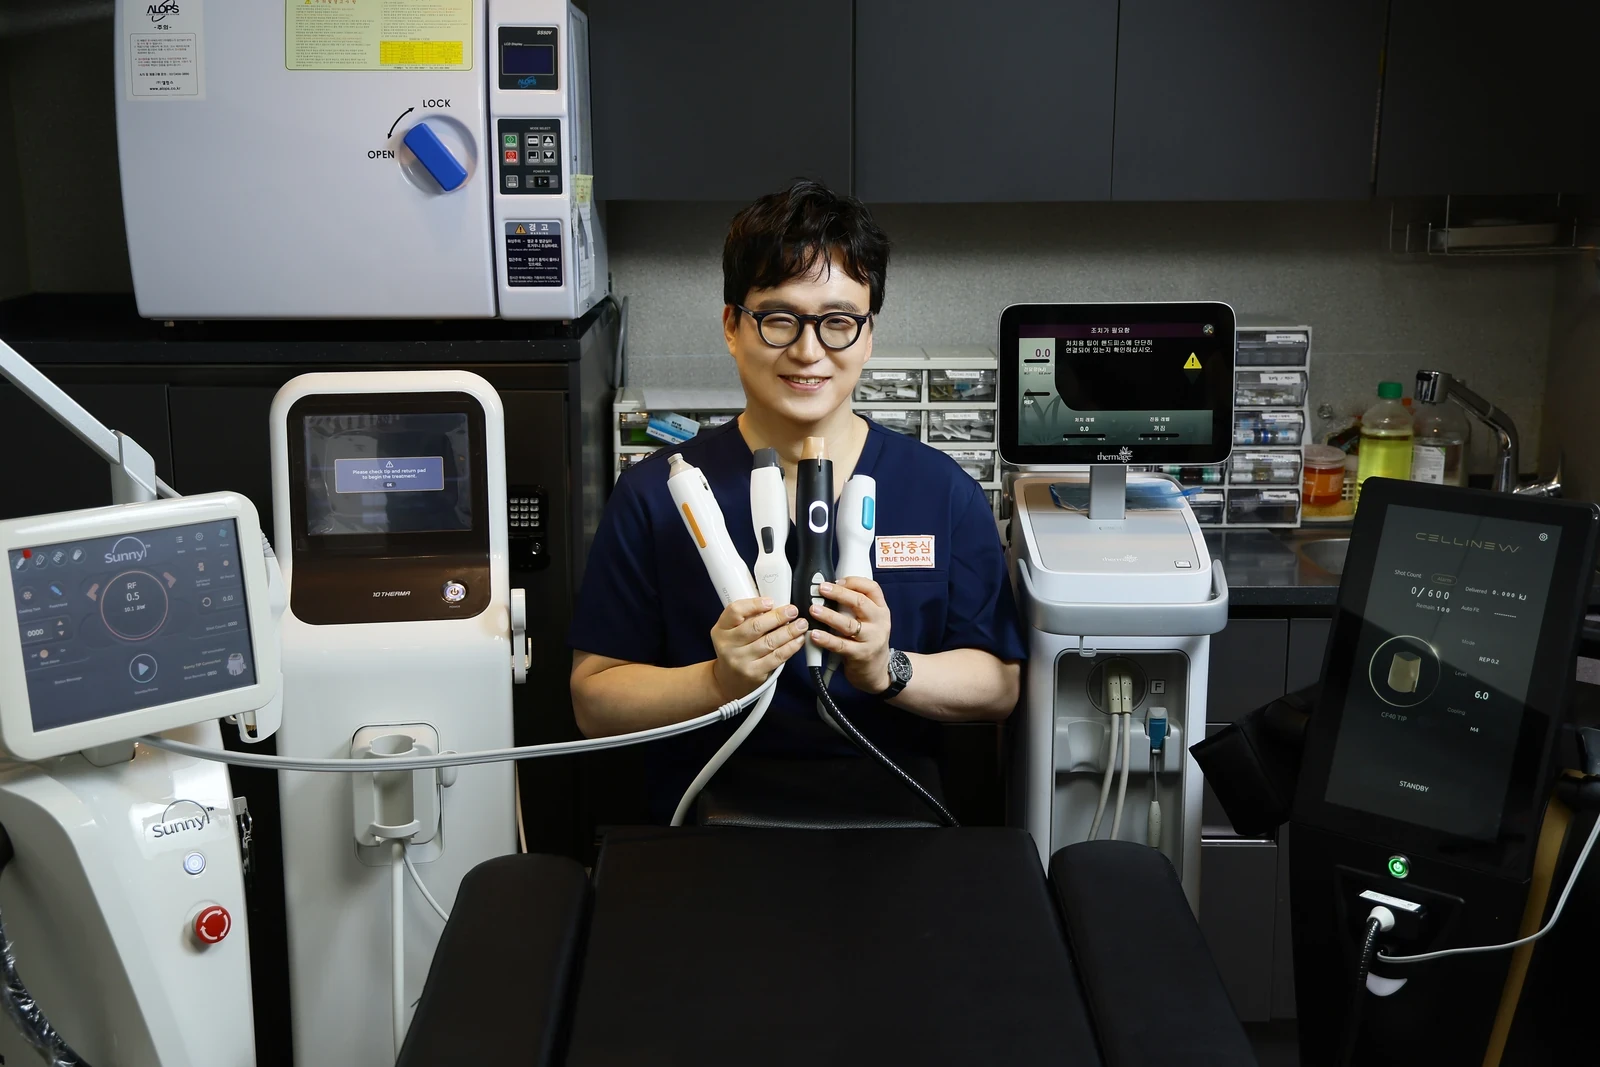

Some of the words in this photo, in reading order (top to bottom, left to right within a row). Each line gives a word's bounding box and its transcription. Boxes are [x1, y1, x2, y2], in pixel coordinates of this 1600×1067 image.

[147, 5, 180, 14] ALOPS
[422, 99, 451, 108] LOCK
[367, 150, 395, 159] OPEN
[1036, 348, 1050, 357] 0.0
[1097, 452, 1131, 463] thermage
[1415, 532, 1519, 553] CELLINEW
[880, 541, 931, 554] 동안중심
[104, 550, 145, 564] Sunny
[127, 582, 137, 590] RF
[1465, 586, 1487, 595] Delivered
[126, 592, 140, 602] 0.5
[1416, 602, 1435, 611] Remain
[27, 629, 44, 637] 0000
[1155, 683, 1161, 691] F
[1474, 690, 1489, 700] 6.0
[1381, 711, 1396, 720] CF40
[1447, 707, 1466, 716] Cooling
[1399, 780, 1429, 792] STANDBY
[152, 815, 206, 838] Sunny
